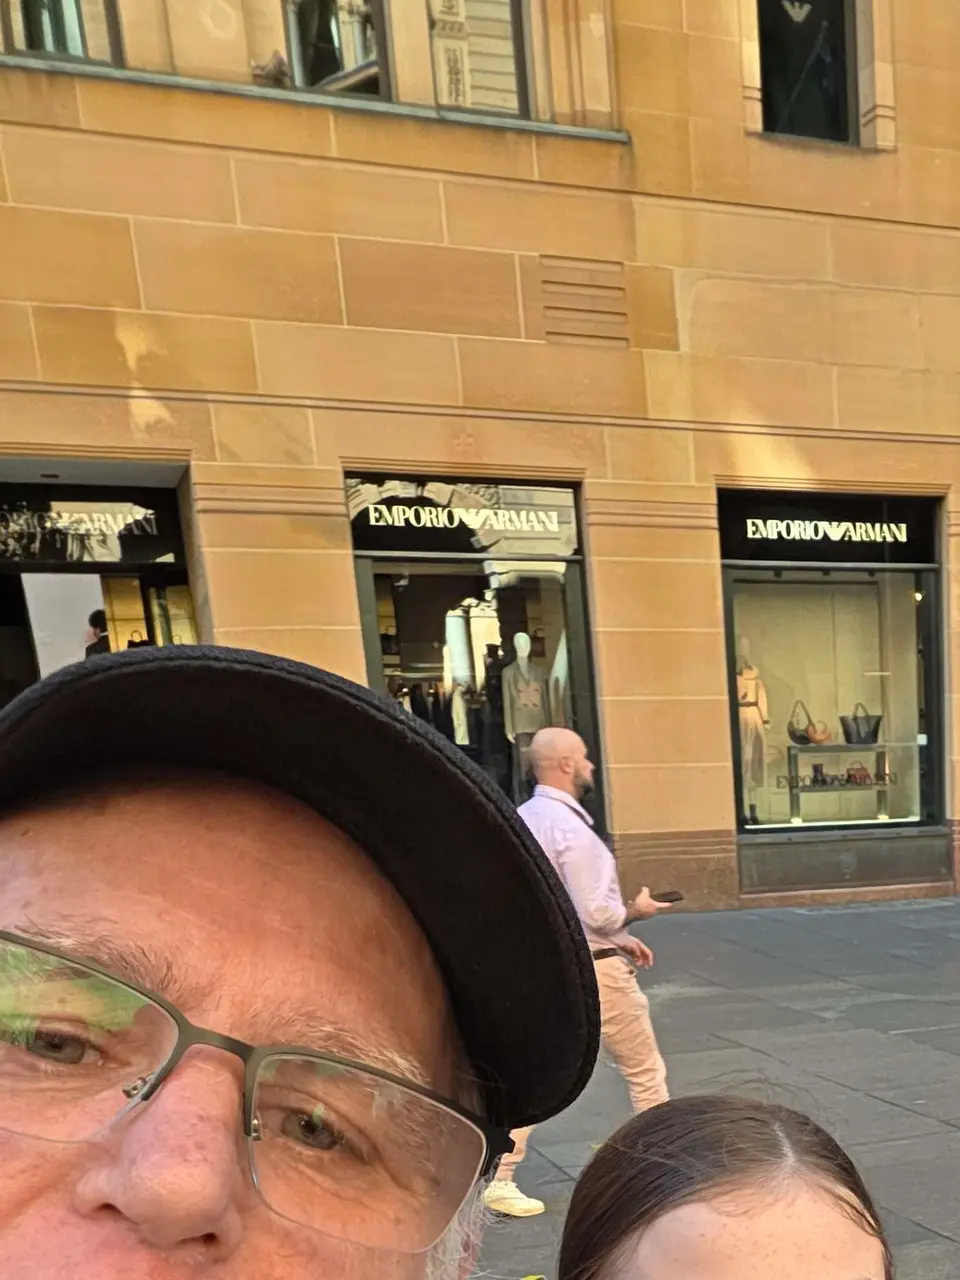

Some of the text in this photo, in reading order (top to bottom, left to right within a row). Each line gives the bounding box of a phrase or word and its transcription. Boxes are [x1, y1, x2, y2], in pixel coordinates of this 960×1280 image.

[368, 504, 561, 532] EMPORIO ARMANI
[746, 519, 907, 542] EMPORIO ARMANI
